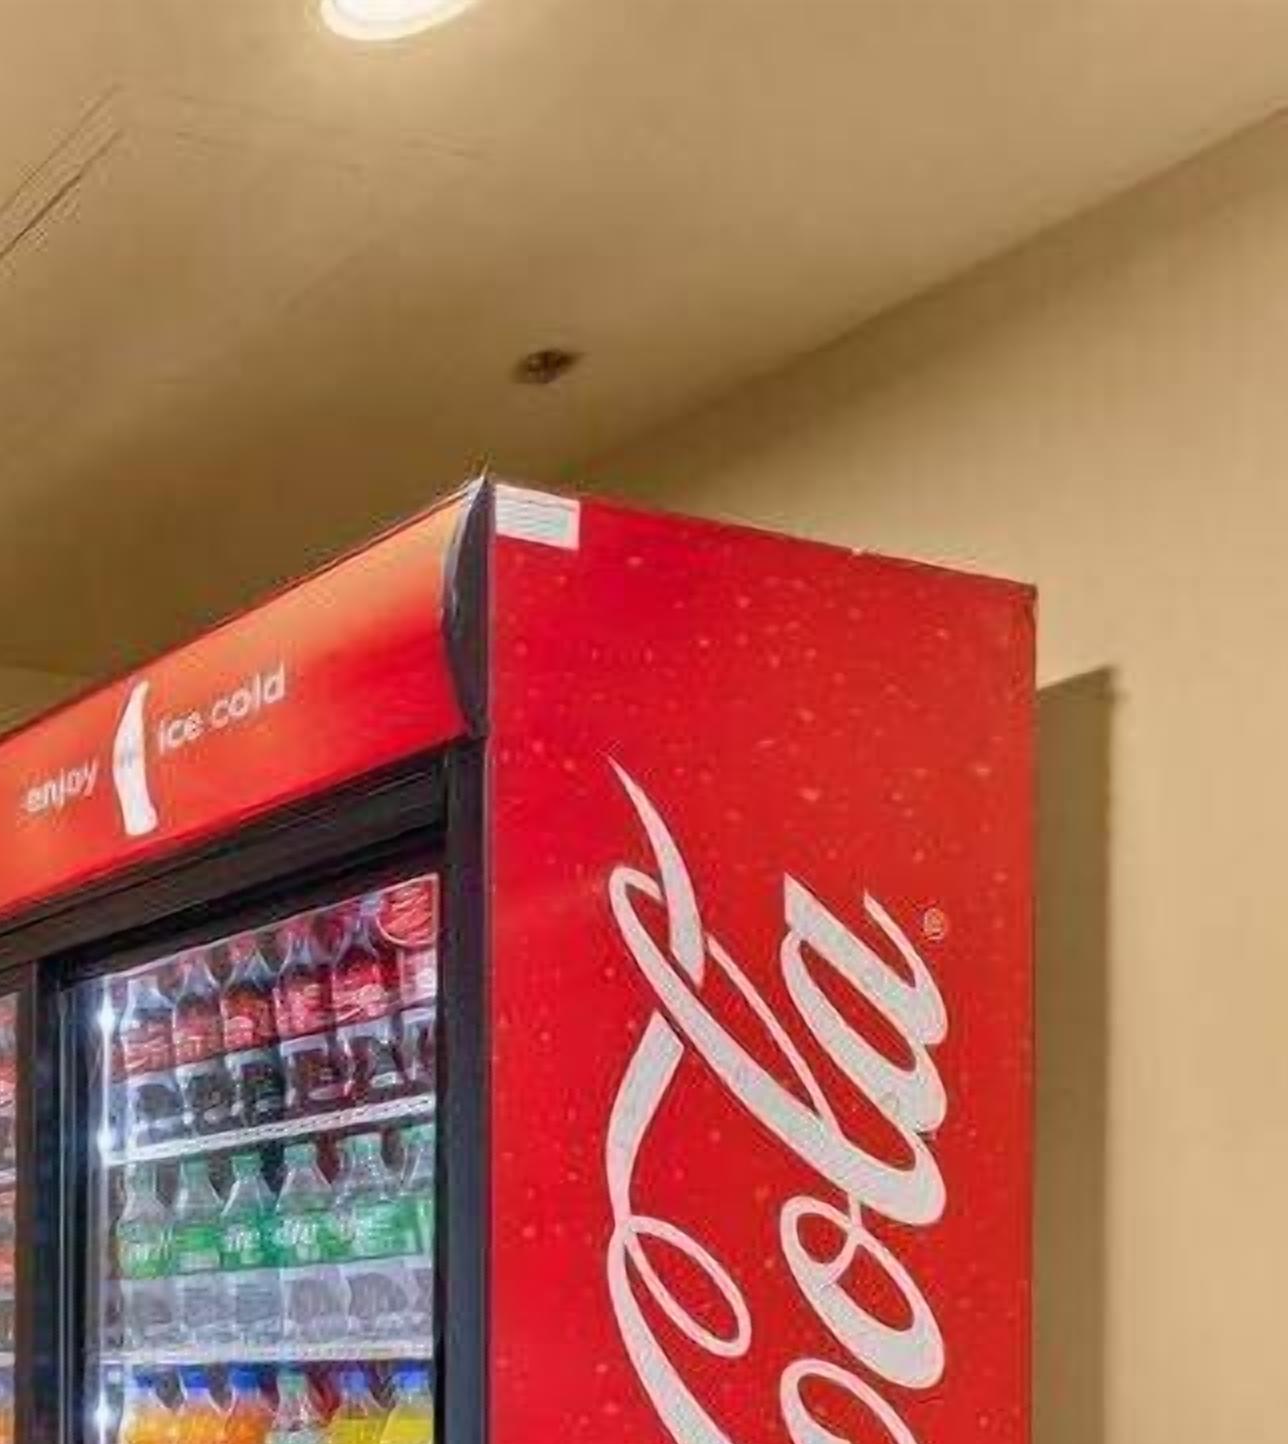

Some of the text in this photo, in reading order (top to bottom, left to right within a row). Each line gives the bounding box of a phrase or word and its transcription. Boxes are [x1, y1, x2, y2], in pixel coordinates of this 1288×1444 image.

[24, 663, 287, 812] enjoy ice cold
